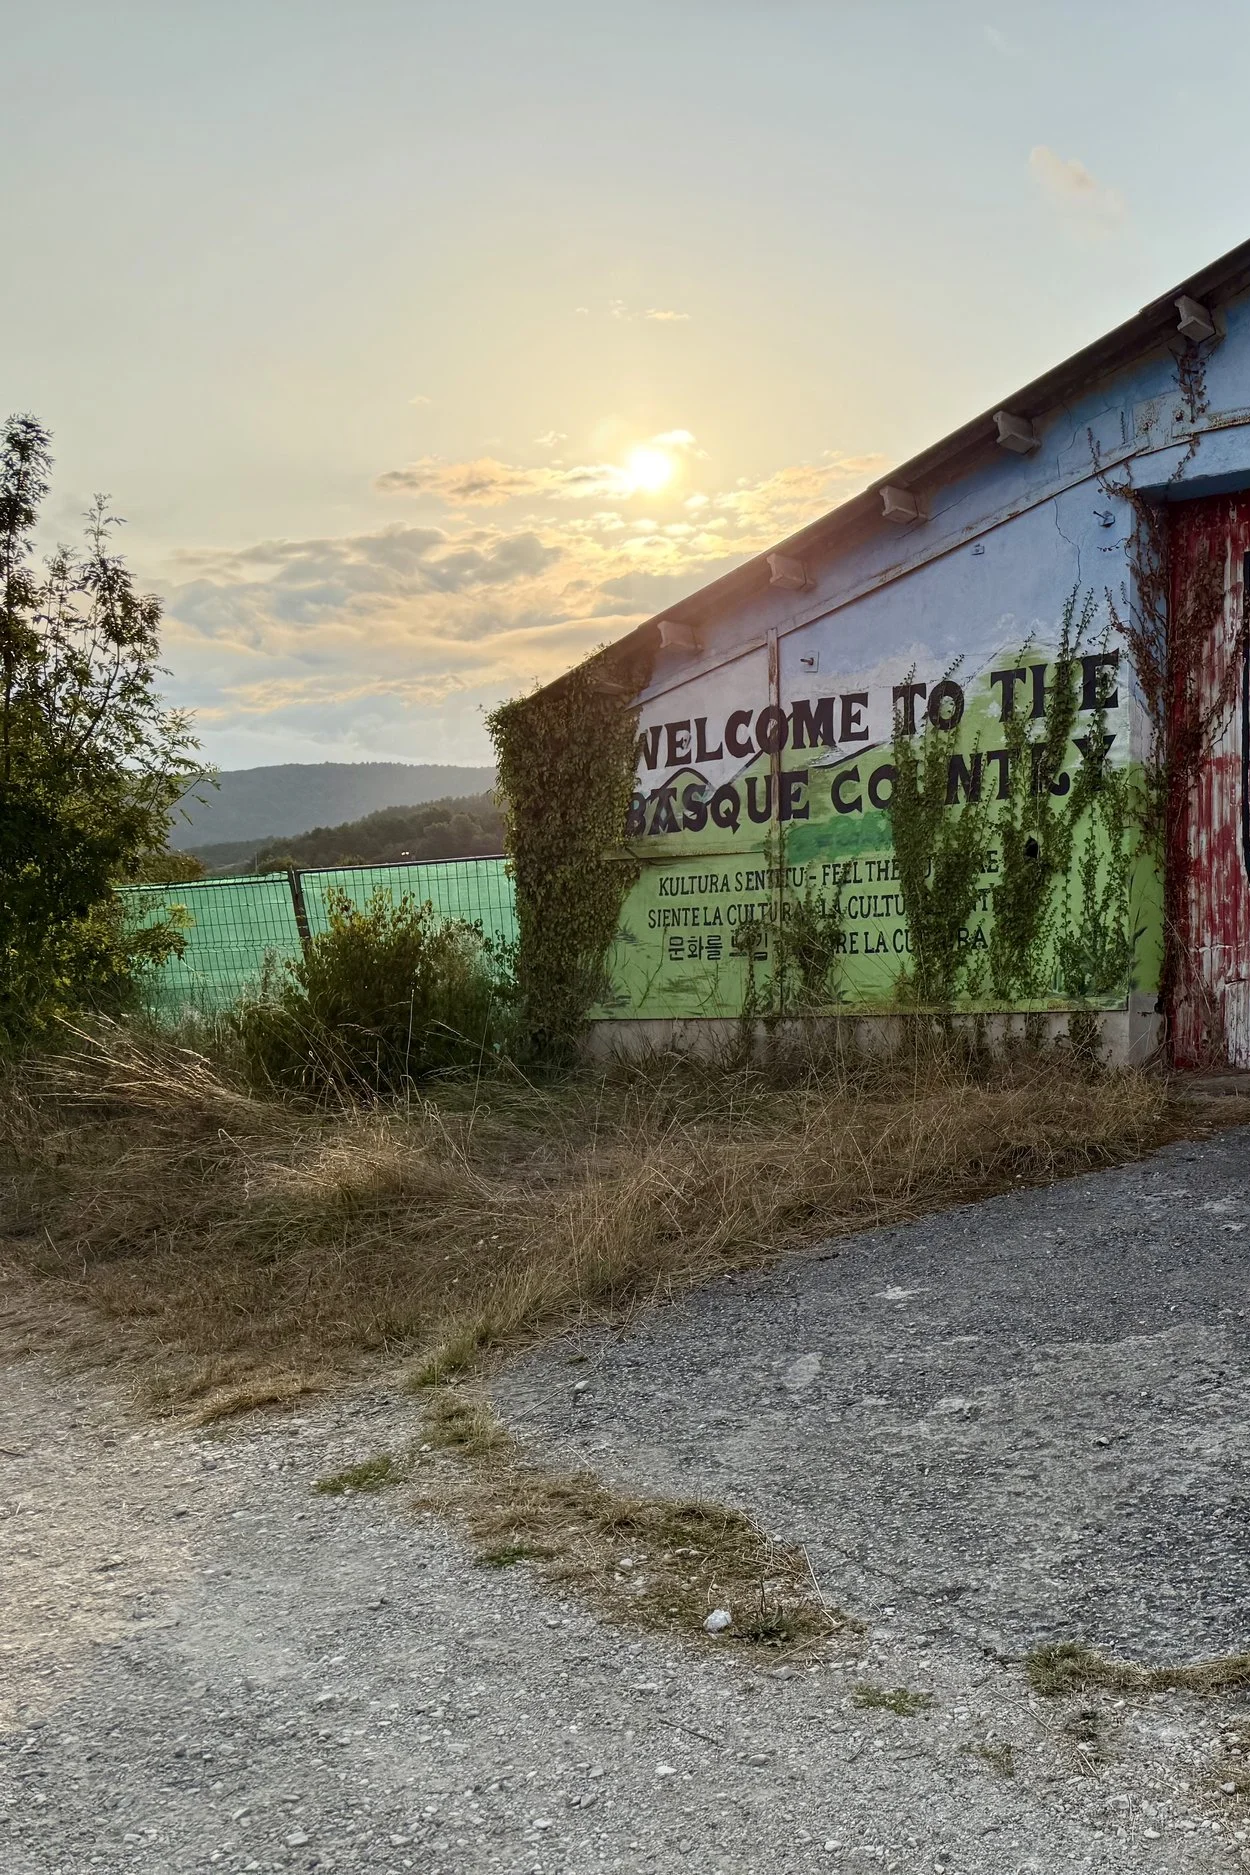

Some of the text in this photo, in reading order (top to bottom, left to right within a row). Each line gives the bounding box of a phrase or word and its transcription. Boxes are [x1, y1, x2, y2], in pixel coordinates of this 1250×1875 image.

[636, 648, 1120, 771] WELCOME TO THE
[626, 770, 810, 837] BASQUE
[658, 873, 731, 897] KULTURA
[821, 860, 863, 886] FEEL
[865, 858, 902, 882] THE
[648, 907, 700, 929] SIENTE
[703, 906, 723, 927] LA
[668, 934, 723, 962] 문화를
[864, 931, 889, 954] LA
